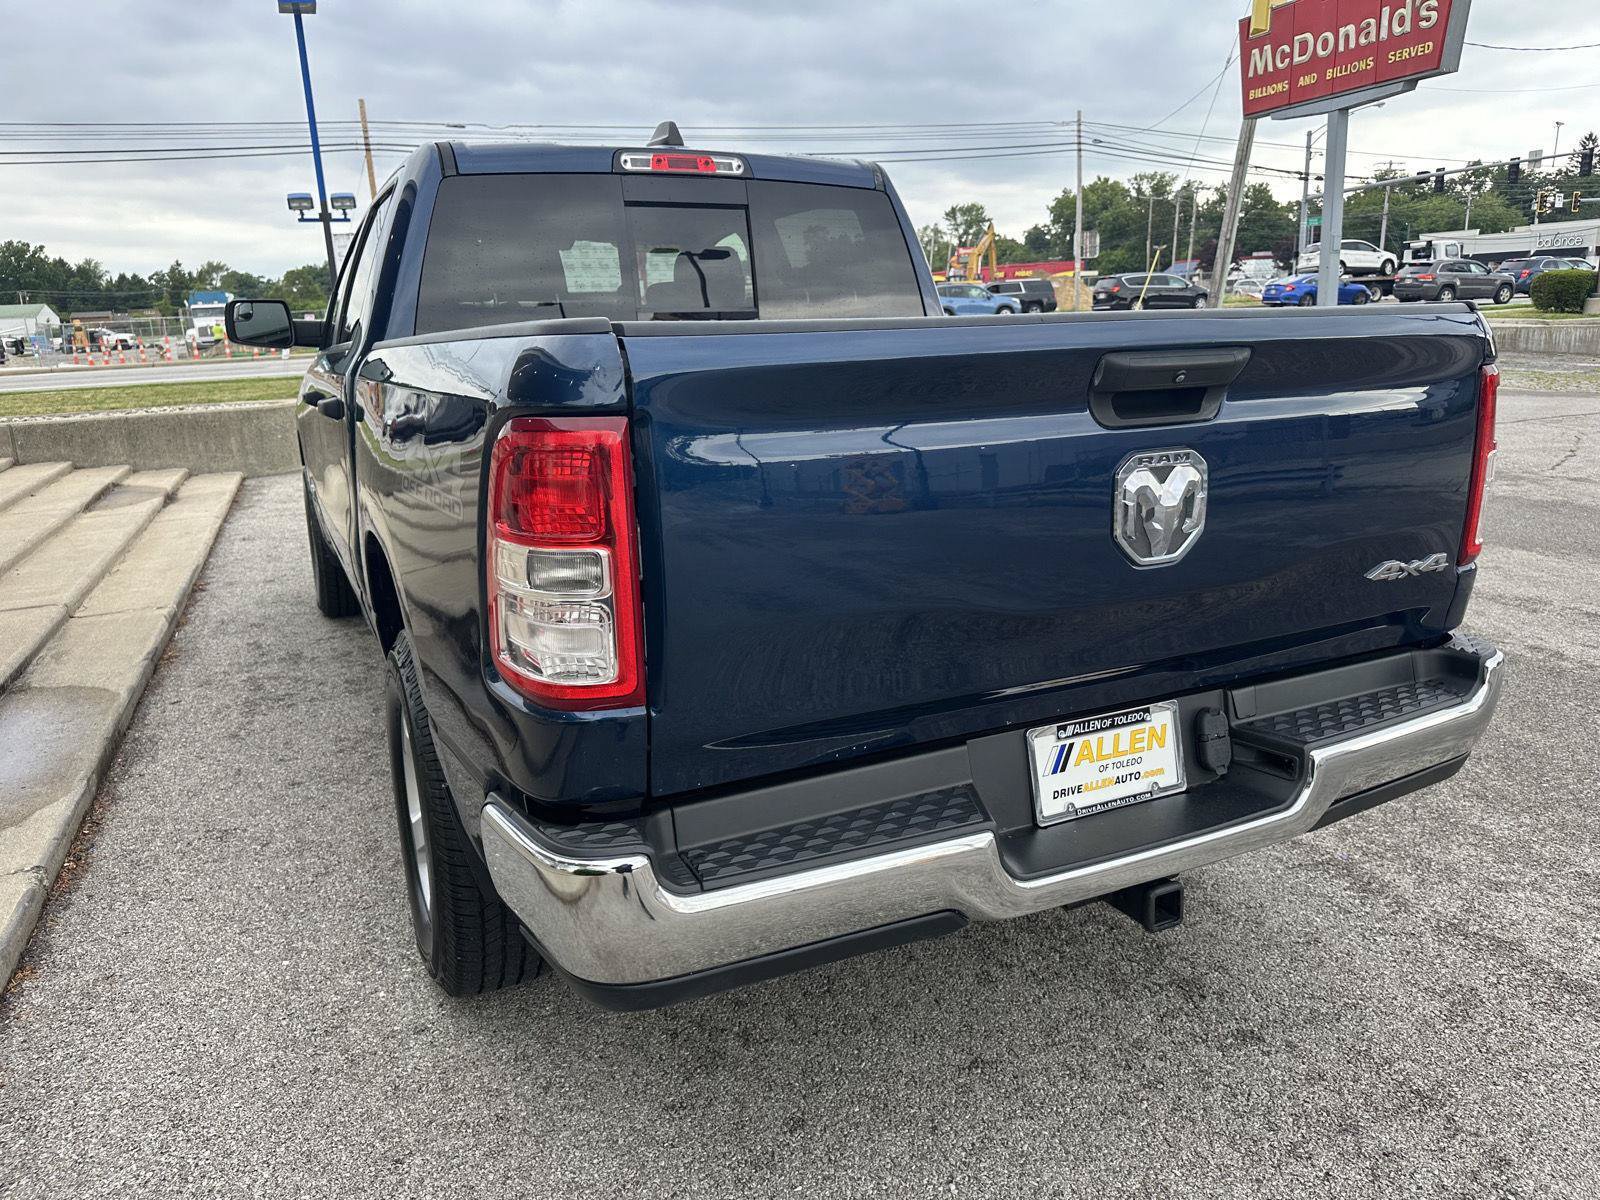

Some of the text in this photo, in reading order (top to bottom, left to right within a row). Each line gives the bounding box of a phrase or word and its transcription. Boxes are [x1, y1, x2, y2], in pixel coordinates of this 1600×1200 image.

[1248, 0, 1439, 78] McDonald's
[1248, 41, 1434, 100] BILLIONS AND BILLIONS SERVED
[1137, 452, 1192, 466] RAM
[1073, 711, 1144, 735] ALLEN OF TOLEDO
[1074, 723, 1167, 767] ALLEN
[1098, 756, 1143, 773] OF TOLEDO
